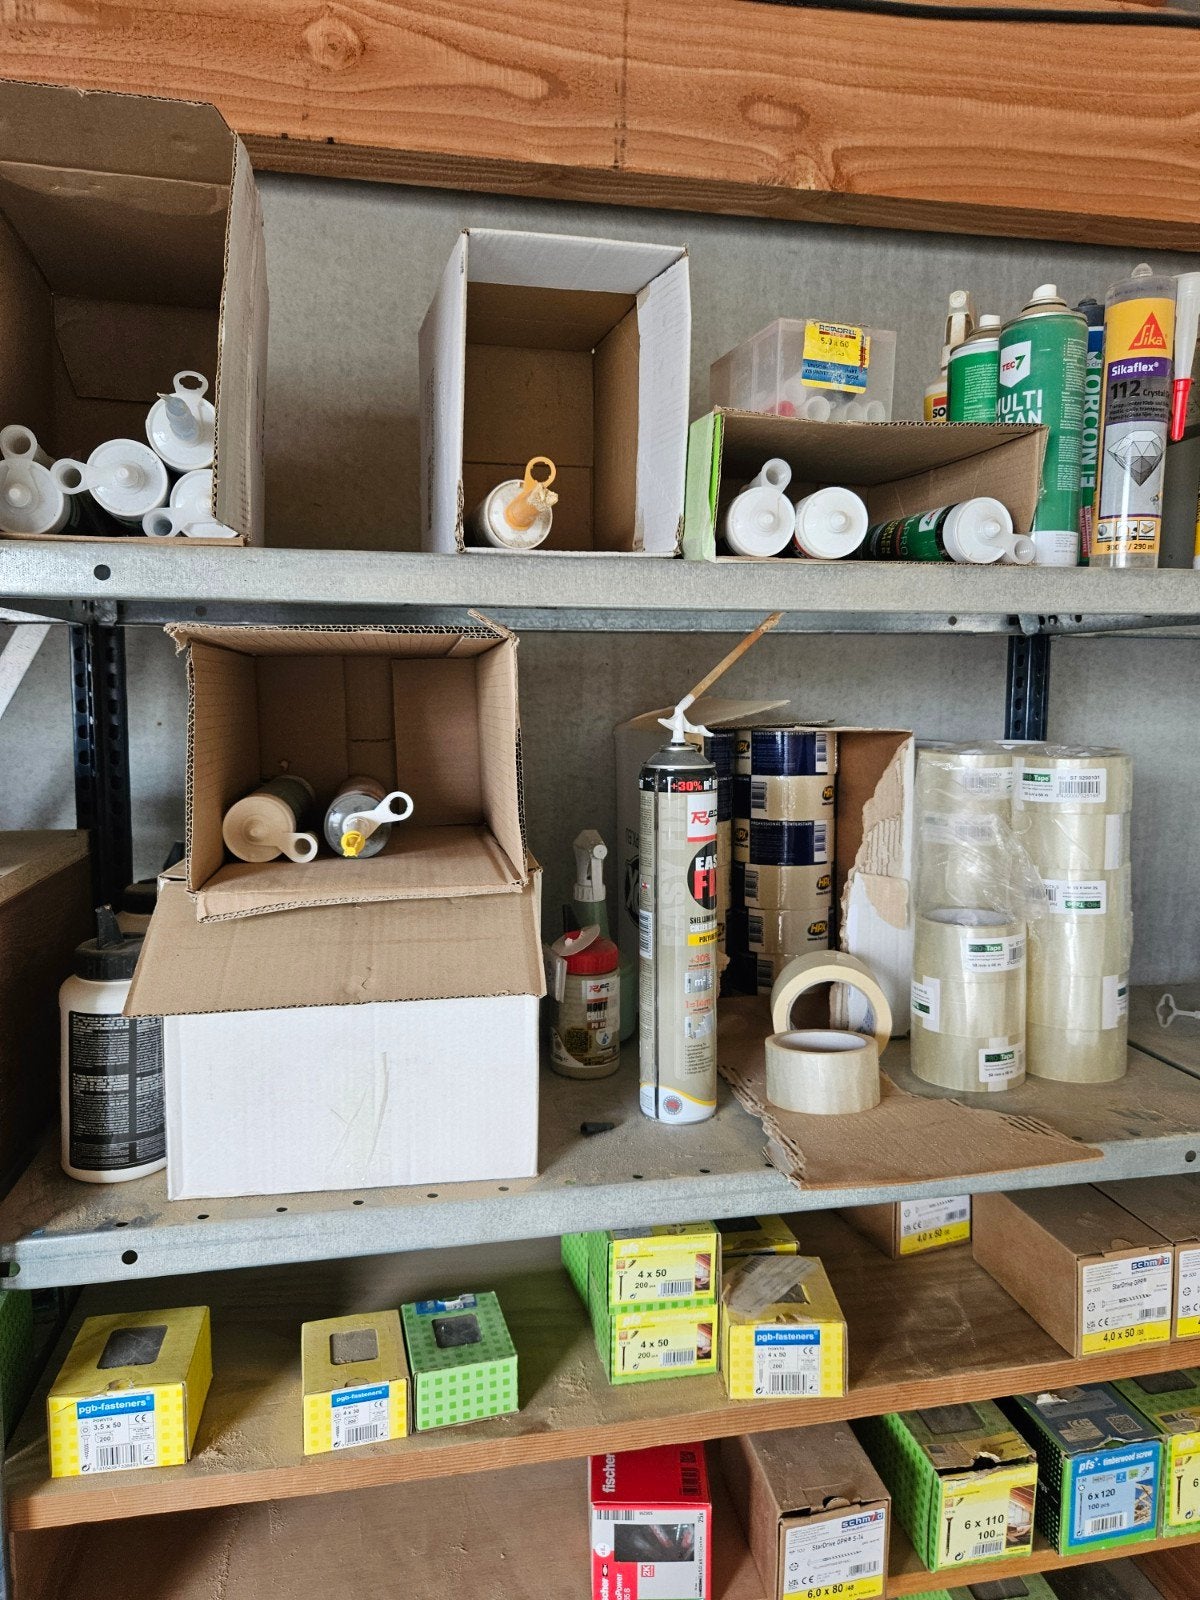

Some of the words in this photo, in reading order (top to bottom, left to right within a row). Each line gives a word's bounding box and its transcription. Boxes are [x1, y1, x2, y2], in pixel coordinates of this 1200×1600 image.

[1134, 324, 1162, 346] Sika
[1002, 355, 1026, 372] TEC7
[1111, 380, 1140, 399] 112
[1081, 374, 1102, 464] ORCON
[671, 781, 703, 791] +30%
[810, 922, 827, 933] HPX
[638, 1270, 644, 1278] 4
[655, 1269, 667, 1278] 50
[1103, 1332, 1116, 1343] 4,0
[1125, 1328, 1135, 1338] 50
[658, 1339, 669, 1347] 50
[113, 1421, 122, 1429] 50
[1102, 1453, 1136, 1466] timberwood
[1136, 1450, 1153, 1460] screw
[602, 1453, 616, 1493] fischer
[1193, 1478, 1199, 1488] 6
[1087, 1493, 1093, 1501] 6
[1101, 1488, 1116, 1498] 120
[964, 1520, 971, 1530] 6
[975, 1520, 981, 1528] x
[985, 1514, 1004, 1526] 110
[978, 1529, 995, 1540] 100
[812, 1541, 836, 1551] StarDrive
[832, 1583, 843, 1594] 80
